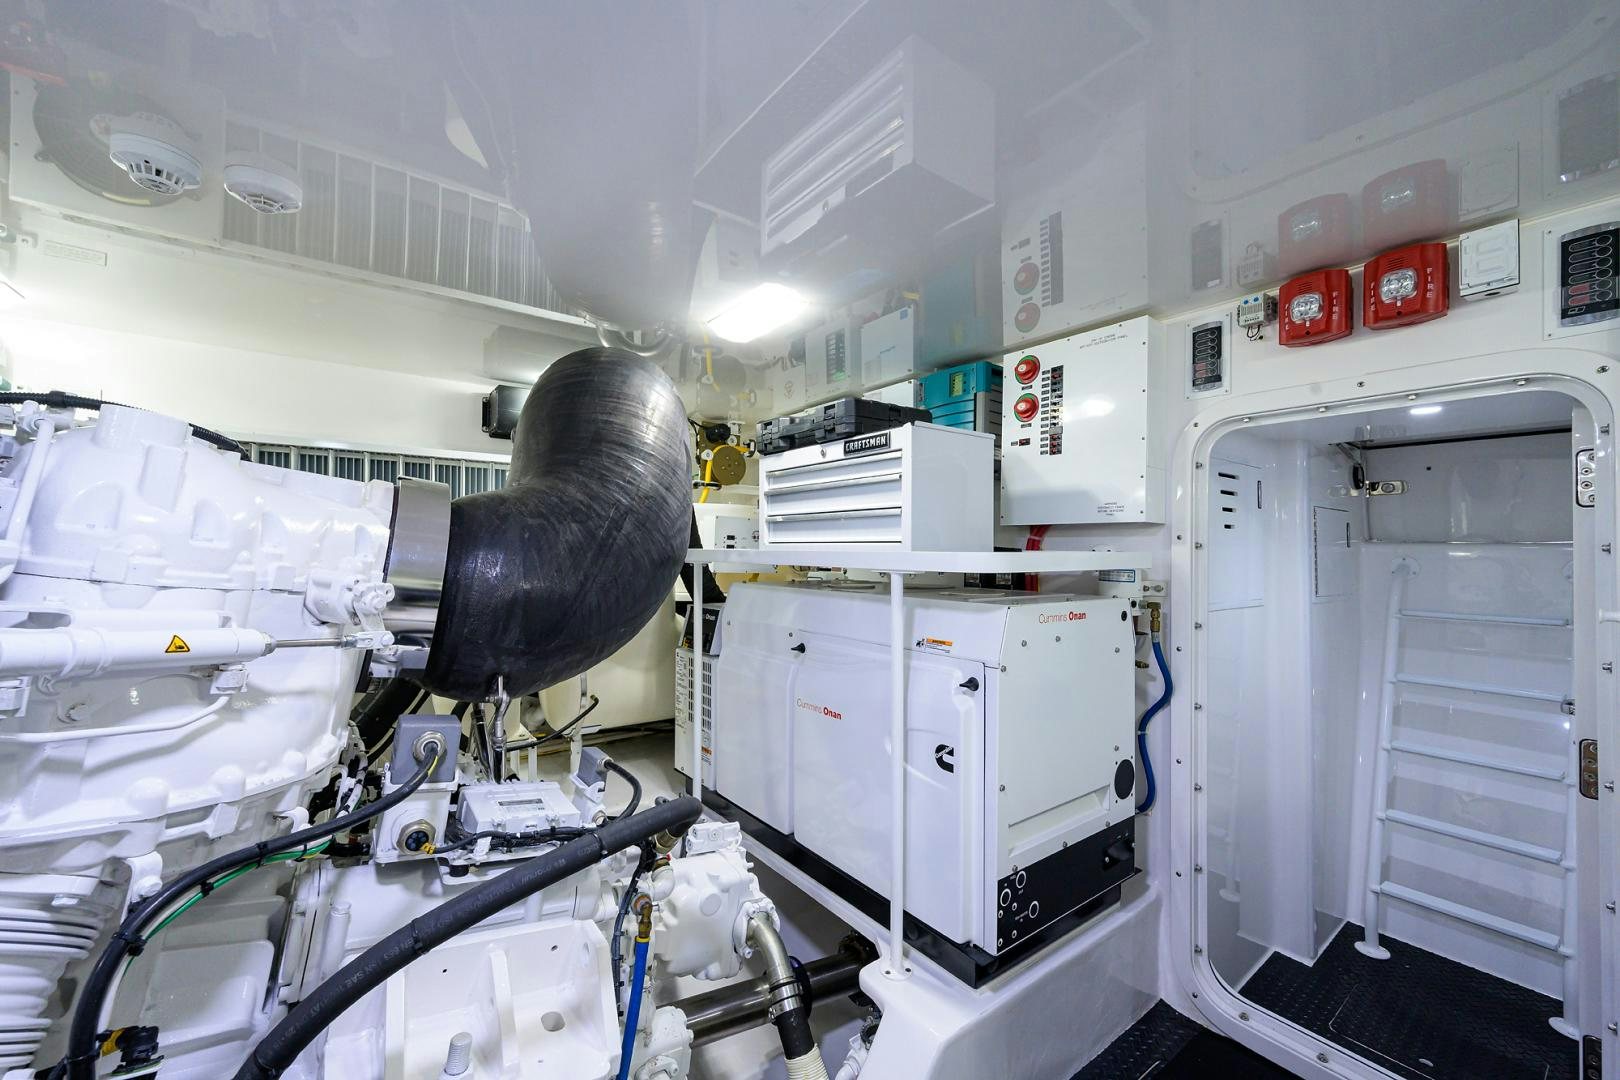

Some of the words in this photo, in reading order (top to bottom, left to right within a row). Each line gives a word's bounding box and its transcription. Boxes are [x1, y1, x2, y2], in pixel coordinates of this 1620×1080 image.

[1426, 267, 1434, 298] FIRE
[845, 436, 886, 451] CRAFTSMAN
[1038, 613, 1068, 624] Cummins
[1068, 611, 1087, 621] Onan
[796, 698, 823, 714] Cummins
[823, 706, 842, 720] Onan
